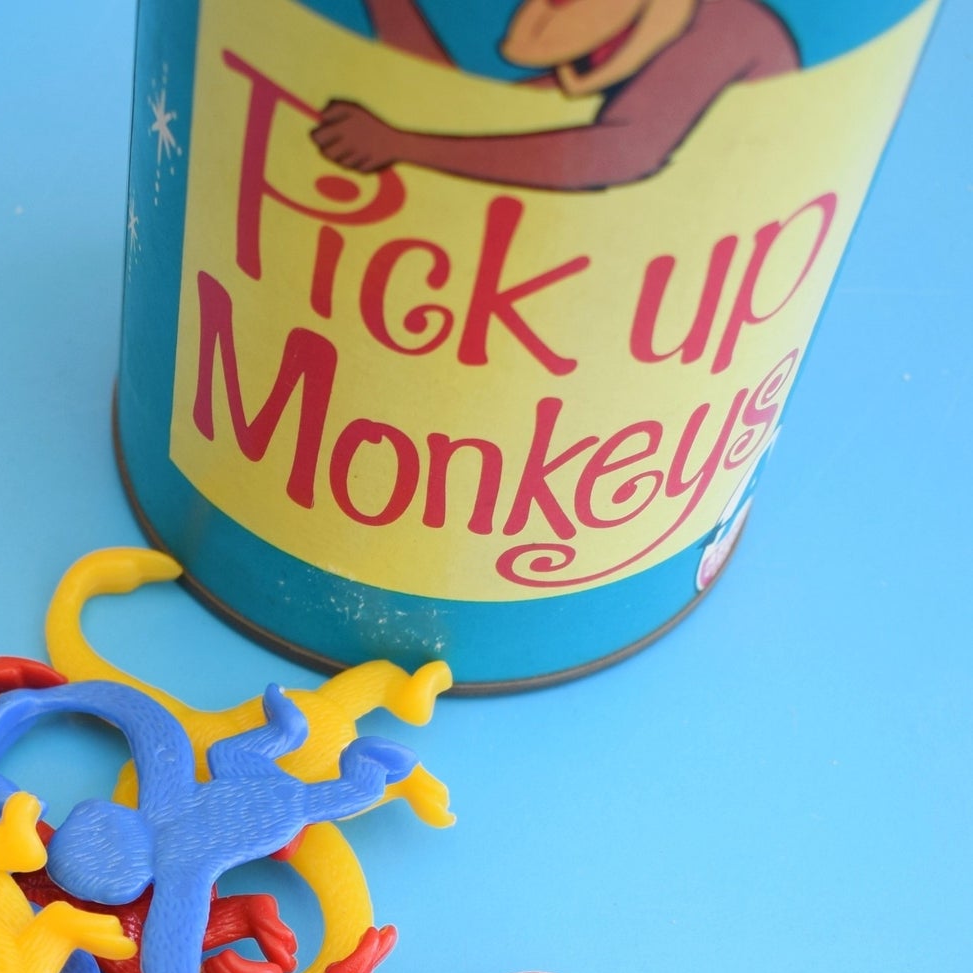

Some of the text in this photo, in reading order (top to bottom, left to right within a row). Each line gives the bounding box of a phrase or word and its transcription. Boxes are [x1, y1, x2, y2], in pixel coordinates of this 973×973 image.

[222, 49, 837, 375] Pick up
[191, 270, 800, 588] Monkeys
